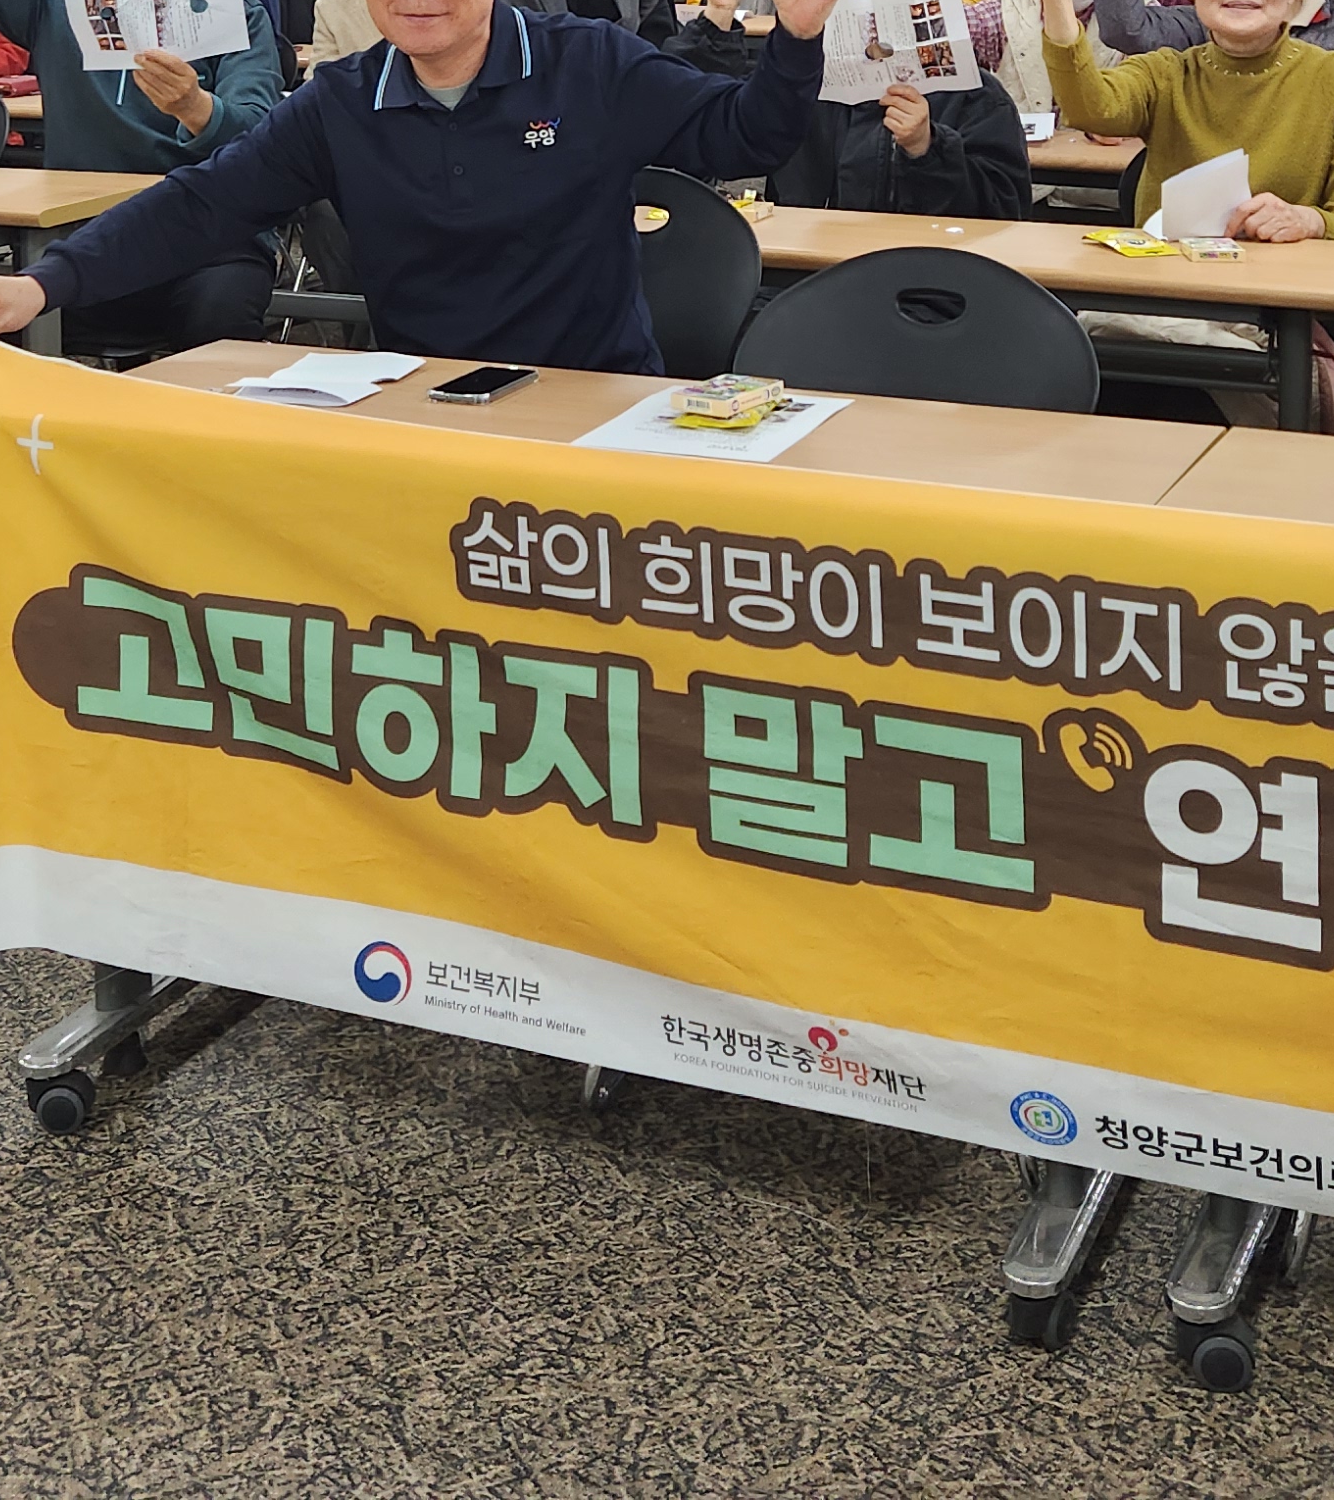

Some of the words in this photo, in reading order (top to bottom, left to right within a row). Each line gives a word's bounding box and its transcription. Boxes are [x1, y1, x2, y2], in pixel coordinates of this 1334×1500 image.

[524, 128, 556, 149] 우양
[463, 511, 611, 609] 삶의
[639, 535, 883, 649] 희망이
[917, 573, 1182, 692] 보이지
[77, 577, 643, 826] 고민하지
[702, 685, 1035, 892] 말고
[426, 961, 541, 1006] 보건복지부
[424, 994, 467, 1014] Ministry
[469, 1004, 481, 1015] of
[483, 1005, 519, 1023] Health
[521, 1013, 543, 1028] and
[545, 1017, 587, 1037] Welfare
[660, 1013, 927, 1102] 한국생명존중희망재단
[673, 1052, 708, 1068] KOREA
[710, 1060, 780, 1083] FOUNDATION
[782, 1075, 805, 1089] FOR
[806, 1080, 849, 1098] SUICIDE
[851, 1090, 919, 1114] PREVENTION
